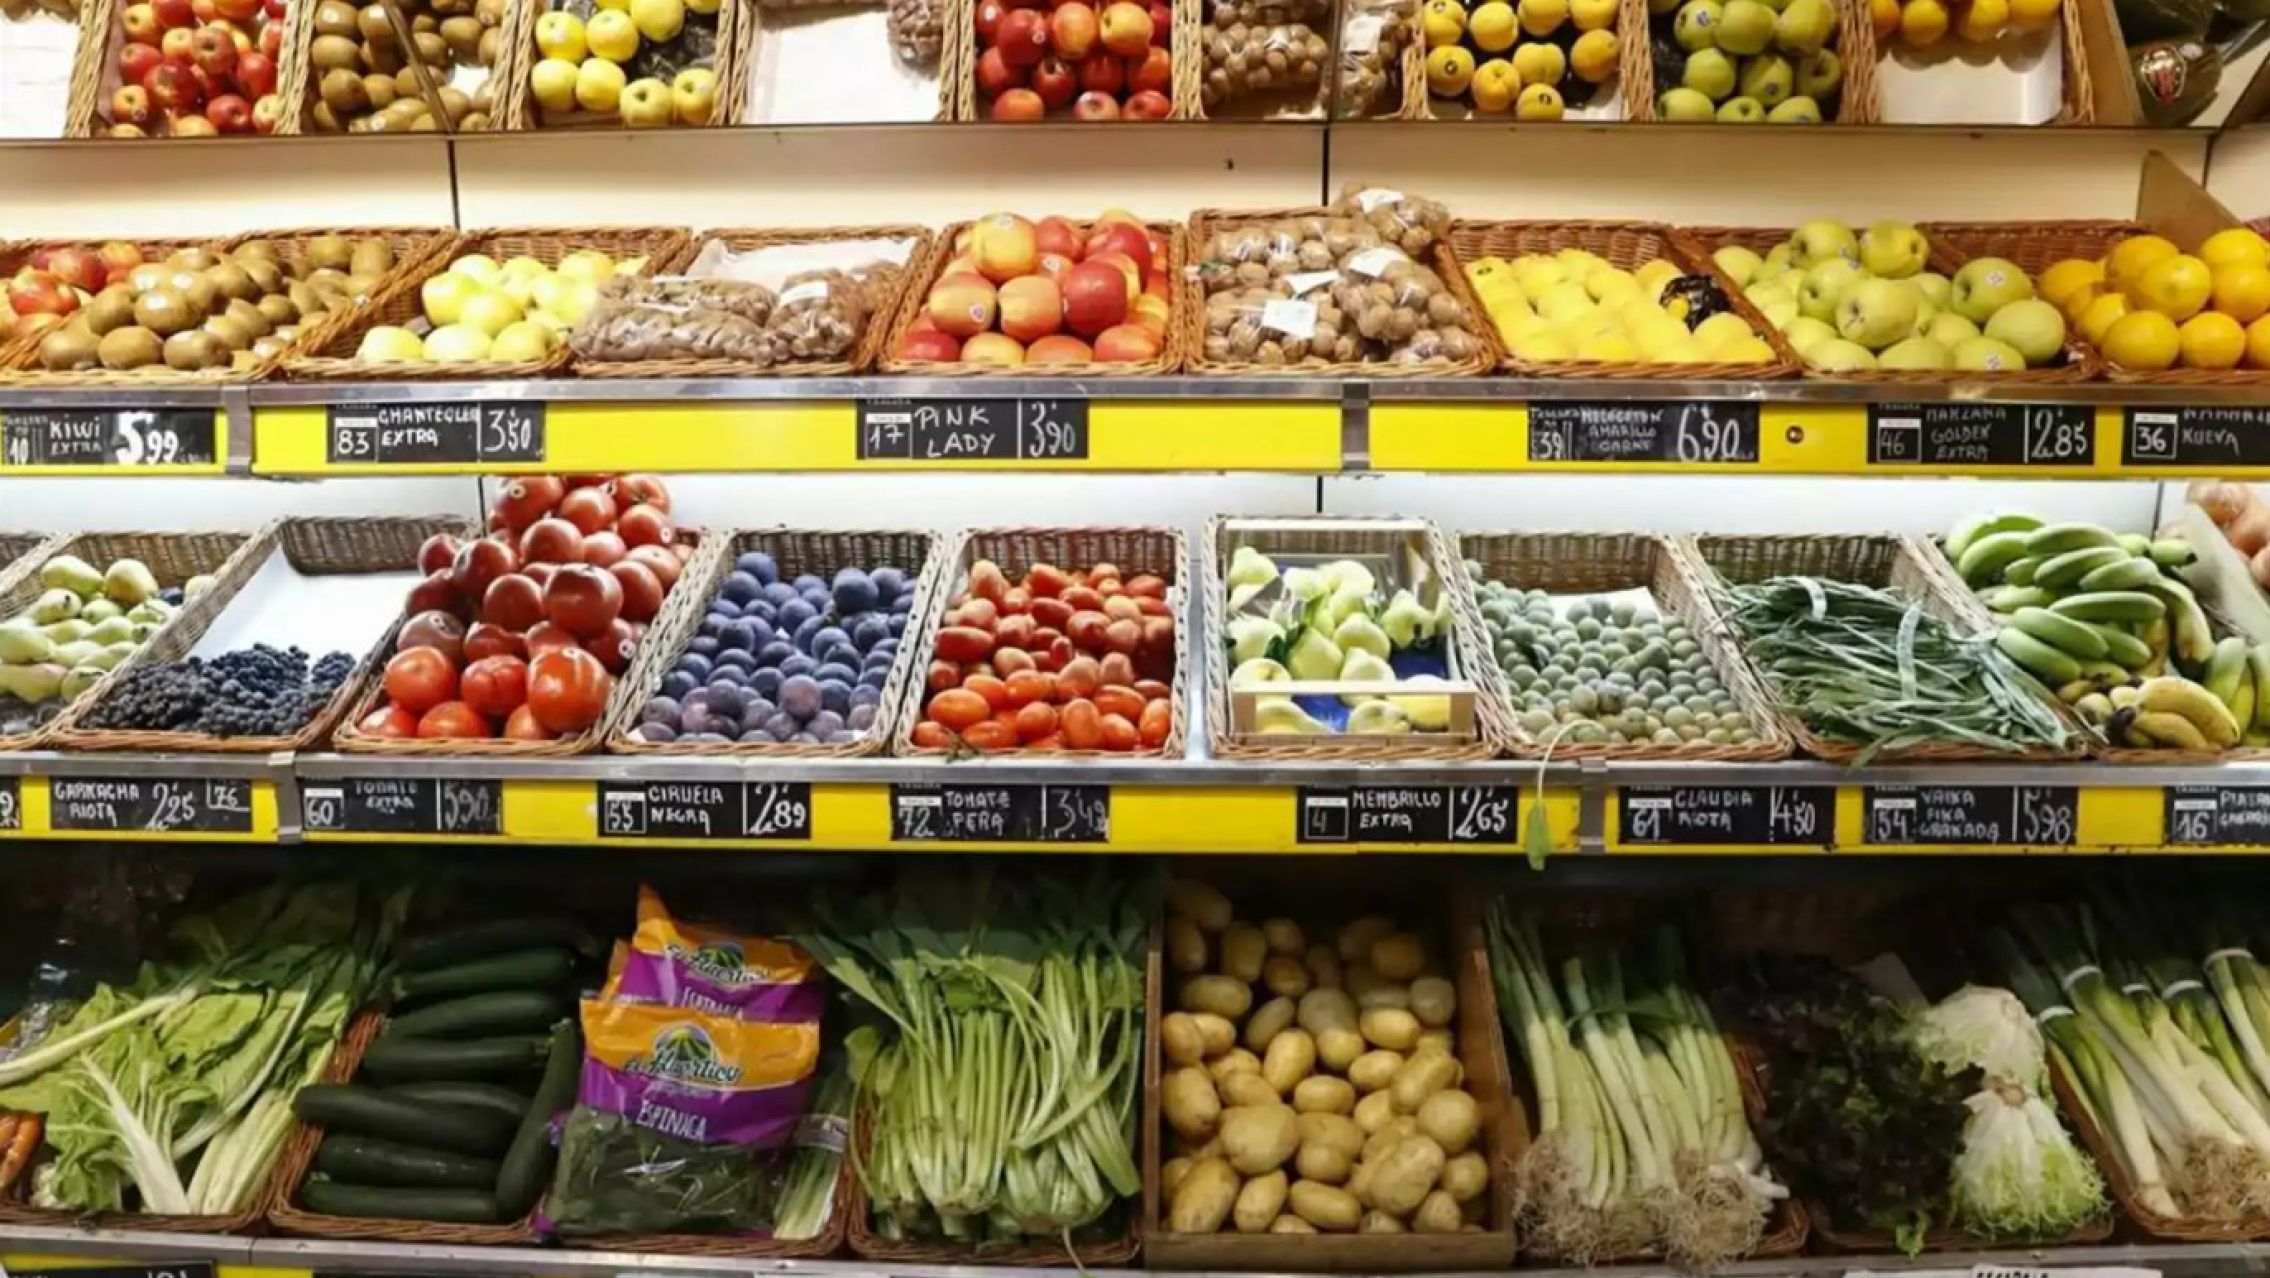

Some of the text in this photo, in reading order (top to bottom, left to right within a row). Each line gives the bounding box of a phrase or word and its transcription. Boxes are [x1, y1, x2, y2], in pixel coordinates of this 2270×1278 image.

[914, 405, 990, 431] PINK
[338, 429, 370, 454] 83
[870, 424, 904, 450] 17
[927, 431, 996, 458] LADY
[2136, 426, 2167, 453] 36
[214, 785, 239, 808] 76
[649, 785, 723, 804] CIRUELA
[944, 790, 1011, 809] TOMATE
[1352, 790, 1442, 809] MEMBRILLO
[1674, 790, 1753, 808] CLAUDIA
[308, 798, 334, 825] 60
[898, 806, 934, 836] 72
[952, 811, 1004, 836] PERA
[1359, 812, 1412, 832] EXTRA
[2177, 811, 2210, 839] 16
[637, 1099, 706, 1141] ESPINACA
